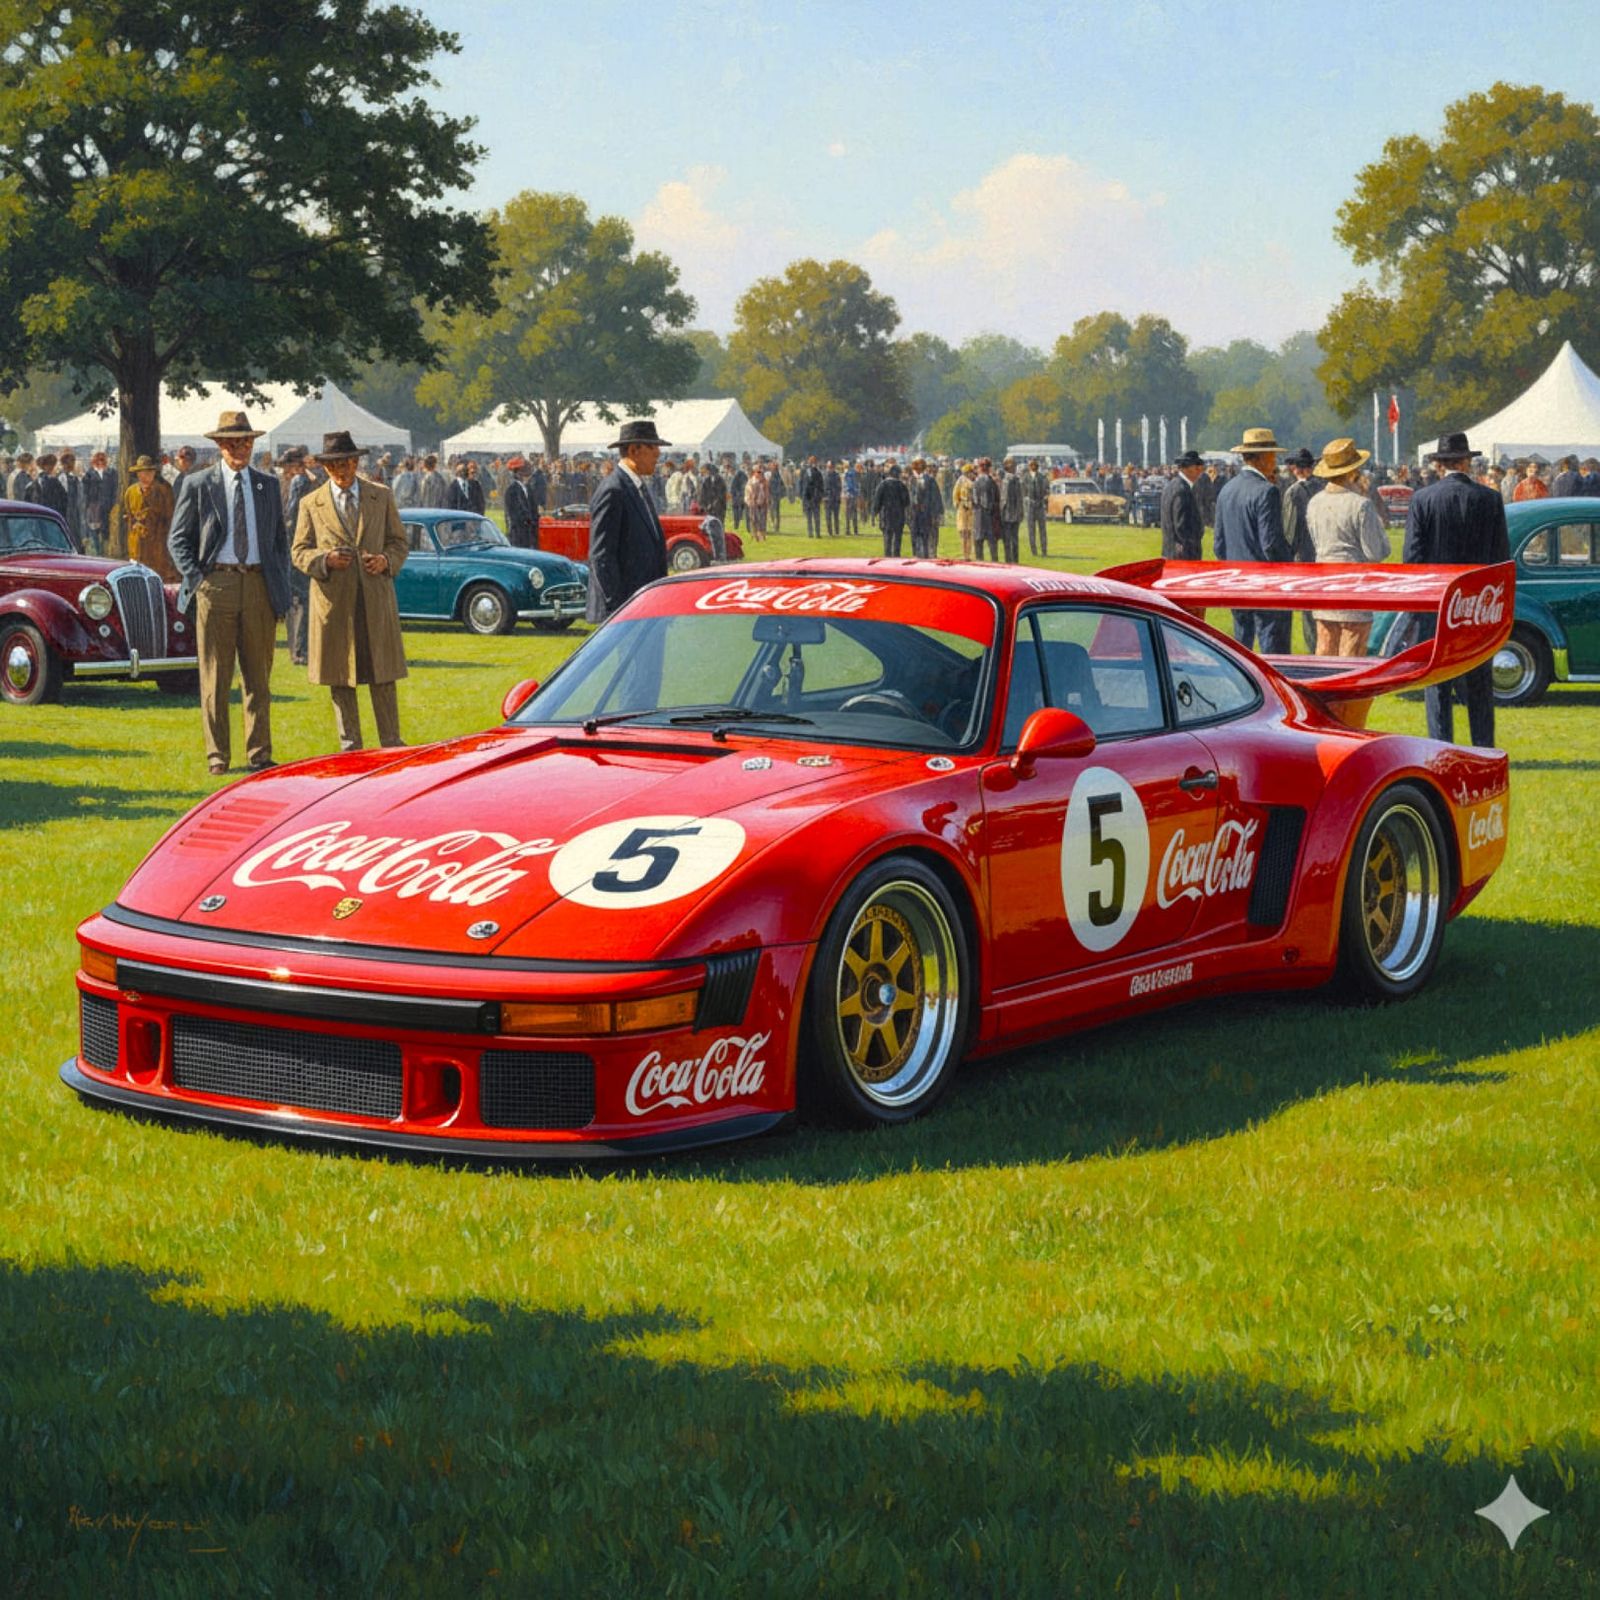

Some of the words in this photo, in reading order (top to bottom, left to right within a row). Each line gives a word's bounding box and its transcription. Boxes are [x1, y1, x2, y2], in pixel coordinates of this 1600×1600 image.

[592, 826, 702, 893] 5
[1087, 792, 1126, 927] 5
[625, 1030, 772, 1116] Coca-Cola
